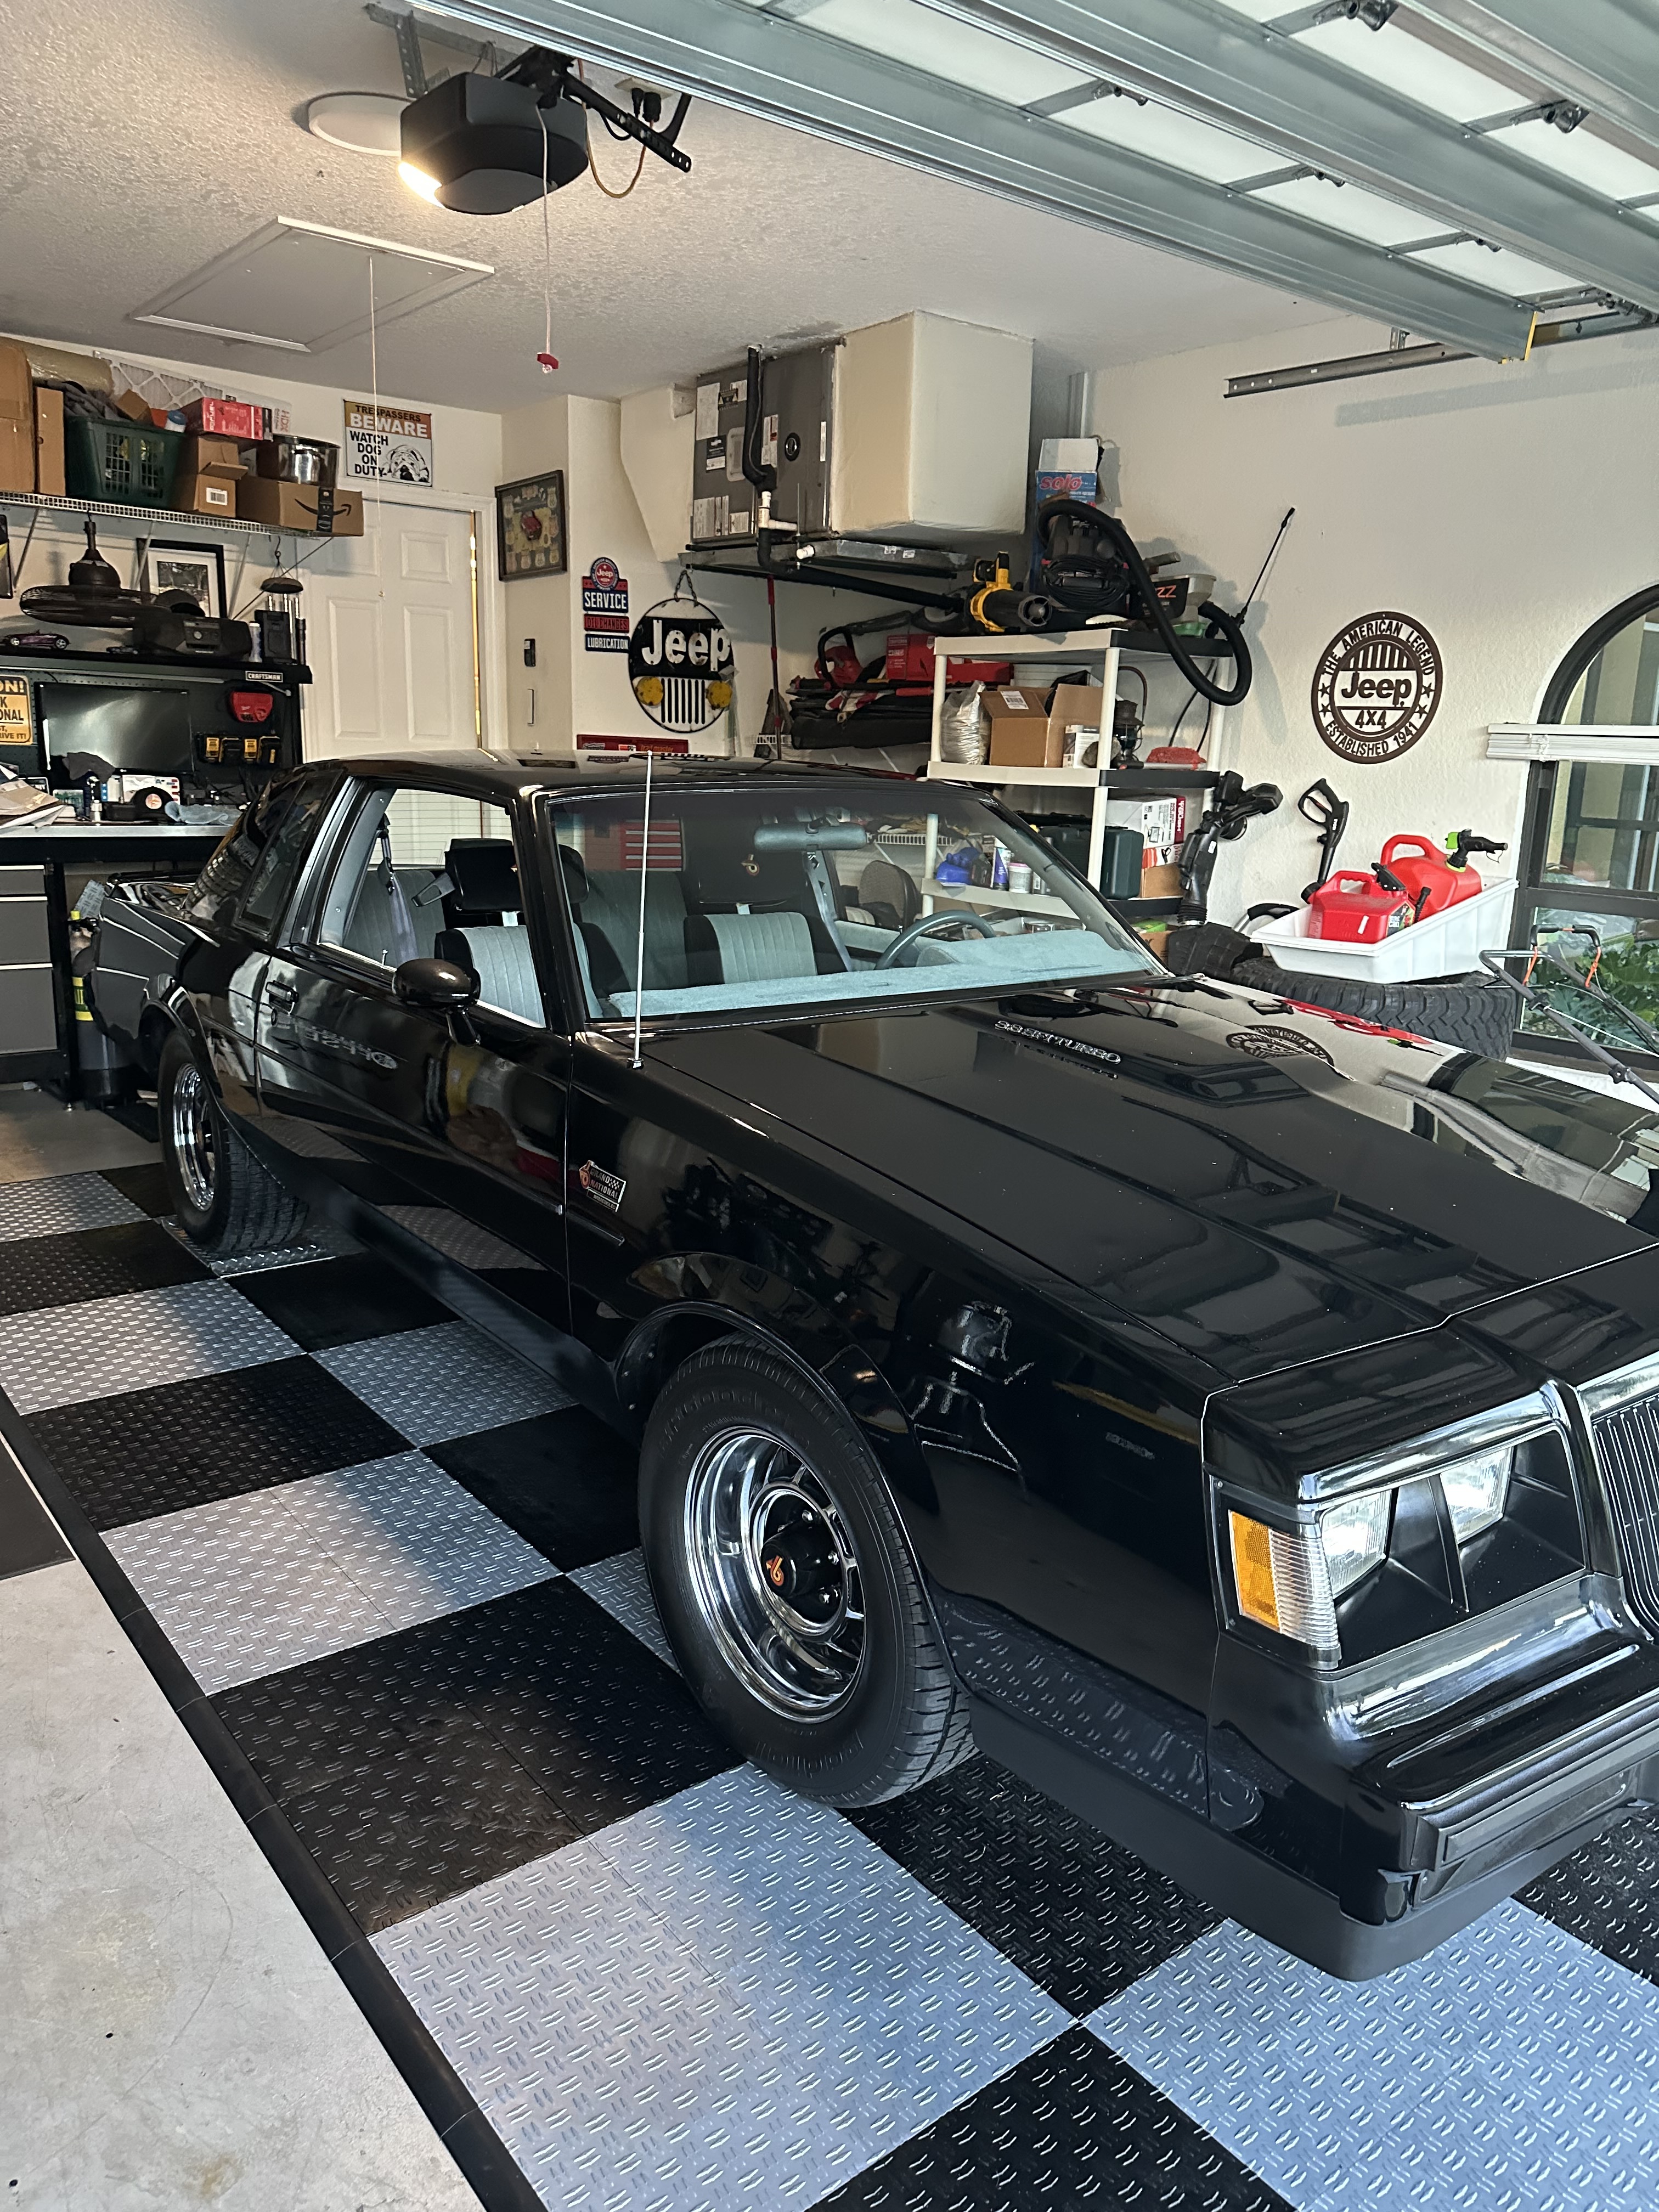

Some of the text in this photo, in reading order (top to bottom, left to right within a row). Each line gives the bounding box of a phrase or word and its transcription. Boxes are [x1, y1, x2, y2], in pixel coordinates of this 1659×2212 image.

[356, 405, 421, 422] TRESPASSERS
[350, 413, 428, 438] BEWARE
[349, 430, 389, 445] WATCH
[357, 442, 382, 455] DOG
[362, 454, 379, 466] ON
[354, 464, 386, 477] DUTY
[1039, 474, 1082, 491] solo
[596, 568, 613, 578] Jeep
[584, 592, 627, 610] SERVICE
[587, 618, 628, 630] OIL CHANGES
[587, 636, 629, 650] LUBRICATION
[641, 619, 731, 672] Jeep
[1323, 620, 1435, 676] THE AMERICAN LEGEND
[1324, 720, 1419, 757] ESTABLISHED 1941
[590, 1168, 611, 1184] GRAND
[590, 1179, 618, 1200] NATIONAL
